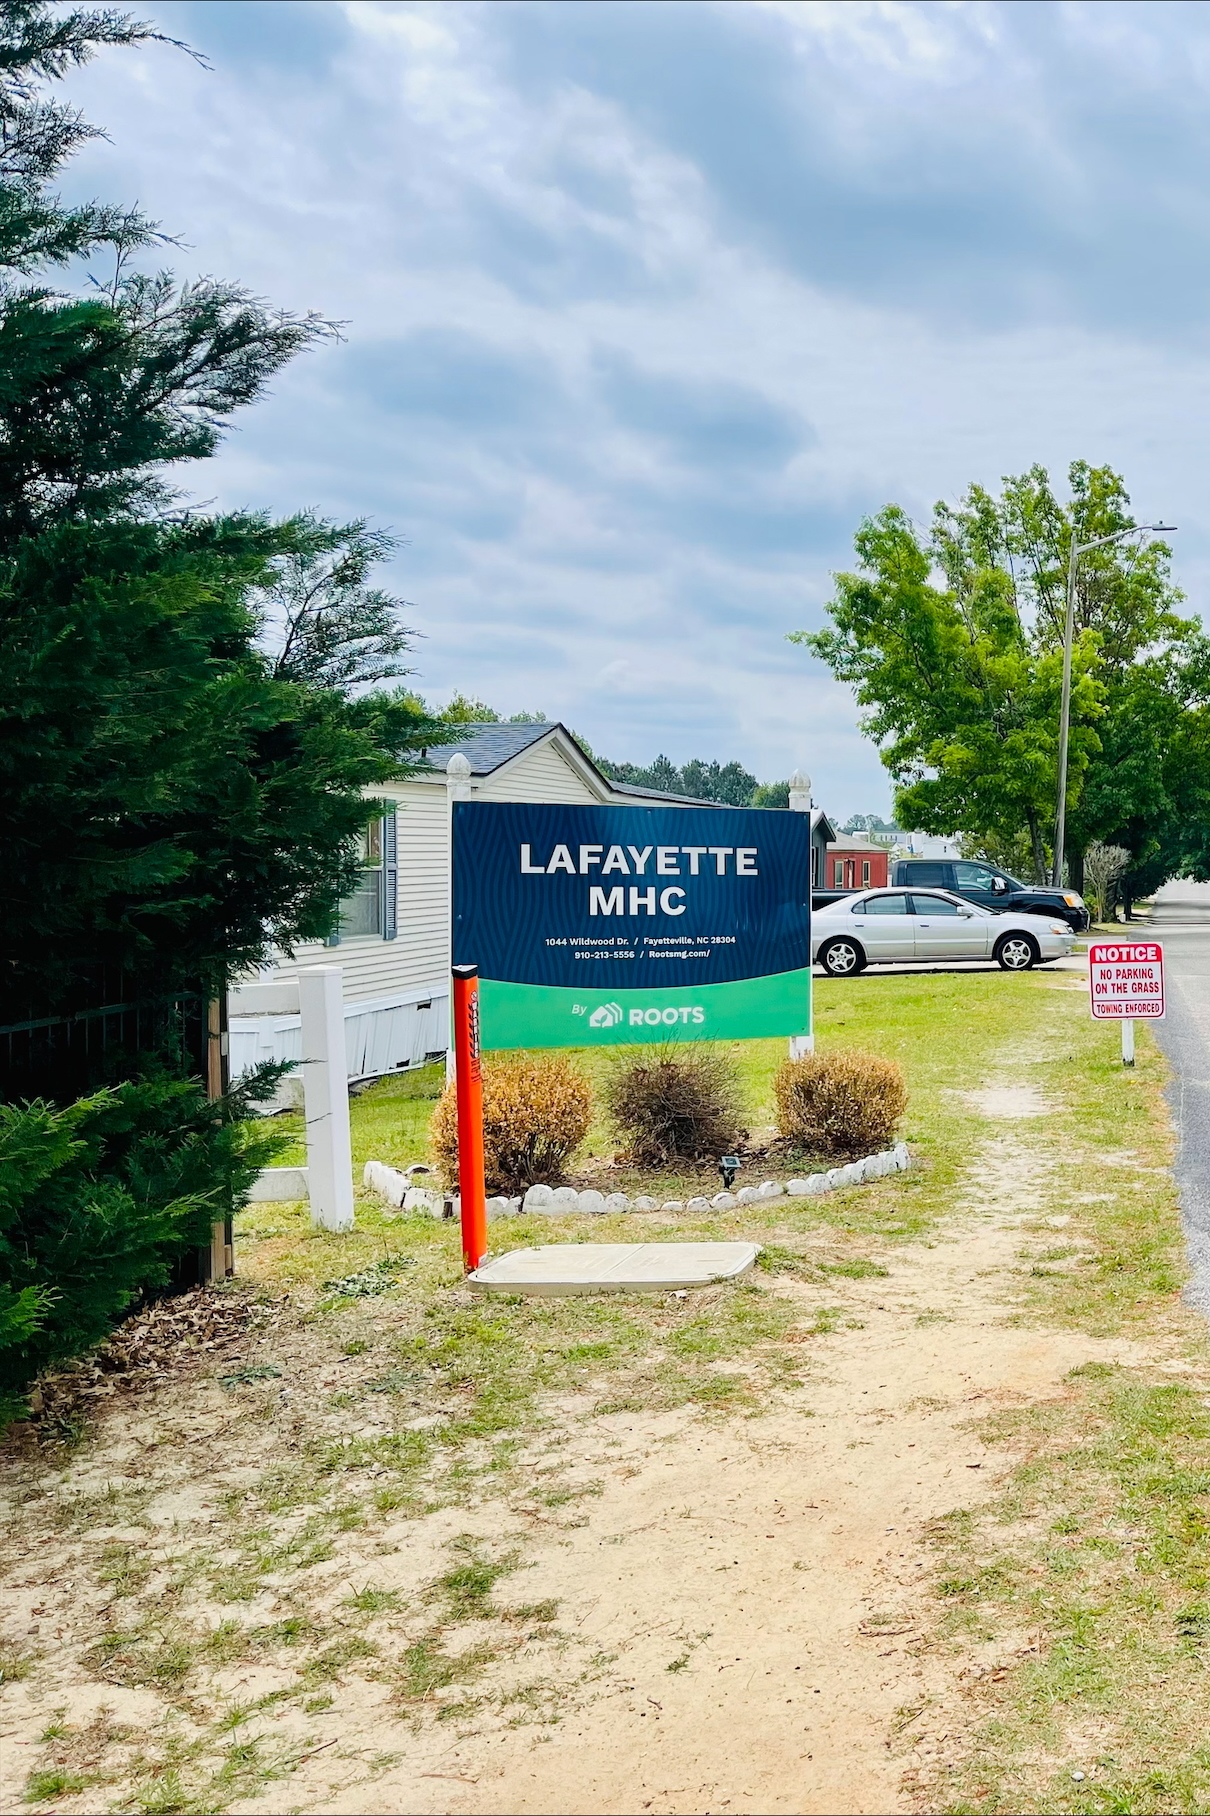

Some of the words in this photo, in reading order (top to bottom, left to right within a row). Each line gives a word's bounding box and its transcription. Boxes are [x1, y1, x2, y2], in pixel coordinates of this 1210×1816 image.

[520, 843, 759, 876] LAFAYETTE
[589, 886, 687, 916] MHC
[545, 938, 568, 946] 1044
[569, 937, 615, 946] Wildwood
[616, 937, 629, 945] Dr.
[643, 936, 695, 947] Fayetteville,
[696, 936, 709, 944] NC
[710, 936, 736, 944] 28304
[574, 950, 635, 960] 910-213-5556
[648, 949, 711, 959] Rootsmg.com/
[1095, 946, 1157, 962] NOTICE
[1100, 969, 1113, 980] NO
[1115, 968, 1153, 980] PARKING
[1095, 983, 1108, 994] ON
[1111, 982, 1128, 994] THE
[1131, 981, 1159, 993] GRASS
[571, 1004, 587, 1016] By
[629, 1006, 705, 1026] ROOTS
[1096, 1004, 1123, 1014] TOWING
[1125, 1003, 1160, 1013] ENFORCED
